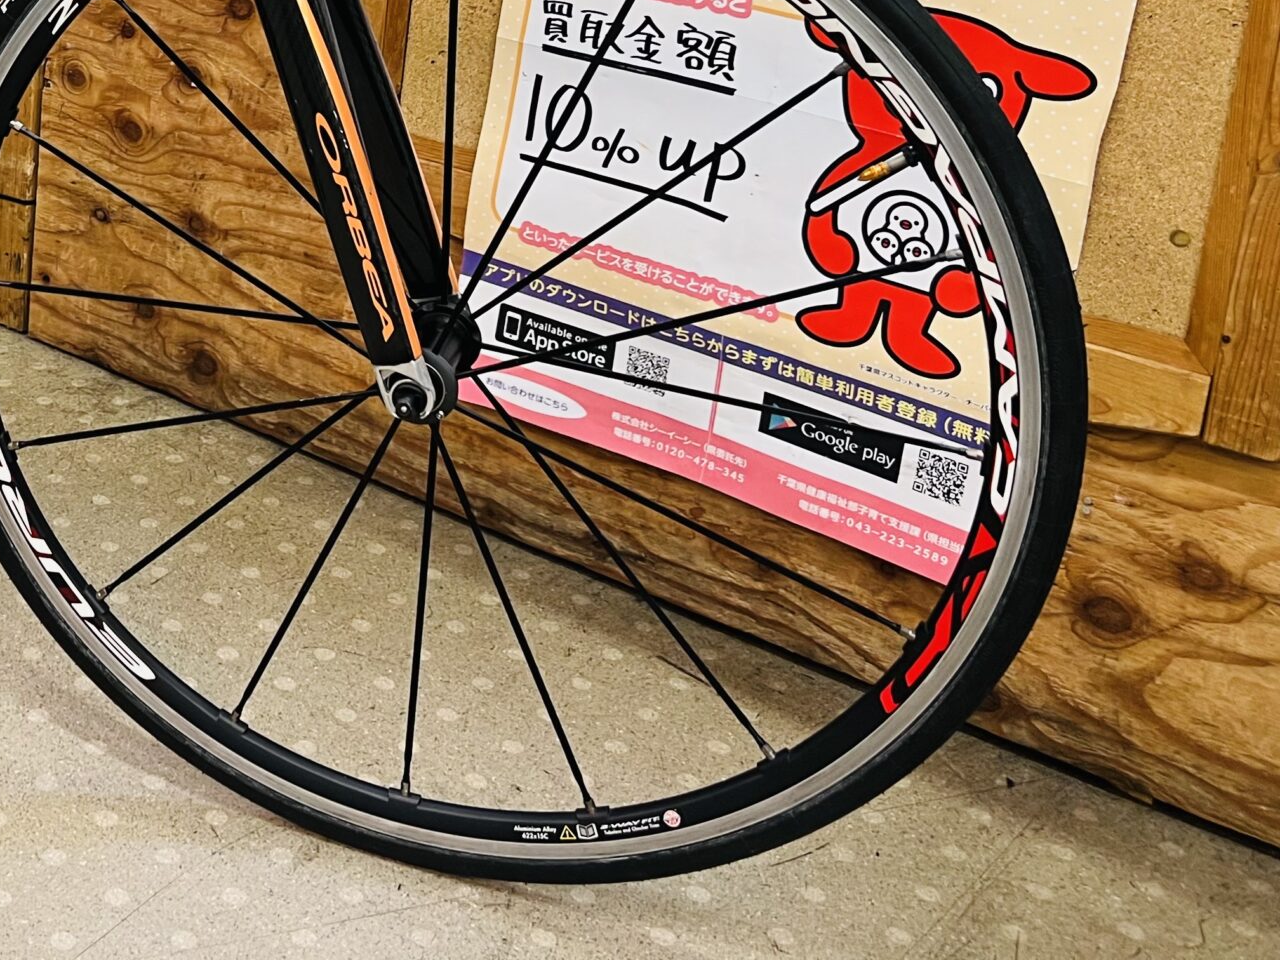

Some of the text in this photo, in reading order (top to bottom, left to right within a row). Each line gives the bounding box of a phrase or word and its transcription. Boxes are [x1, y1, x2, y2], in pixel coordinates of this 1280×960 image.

[542, 0, 738, 82] 買取金額
[524, 73, 641, 169] 10%
[315, 112, 395, 343] ORBEA
[523, 329, 560, 352] App
[525, 317, 573, 340] Available
[485, 376, 569, 412] お問い合わせはこちら
[611, 410, 702, 449] 株式会社シーイーシー
[800, 421, 896, 470] Google play
